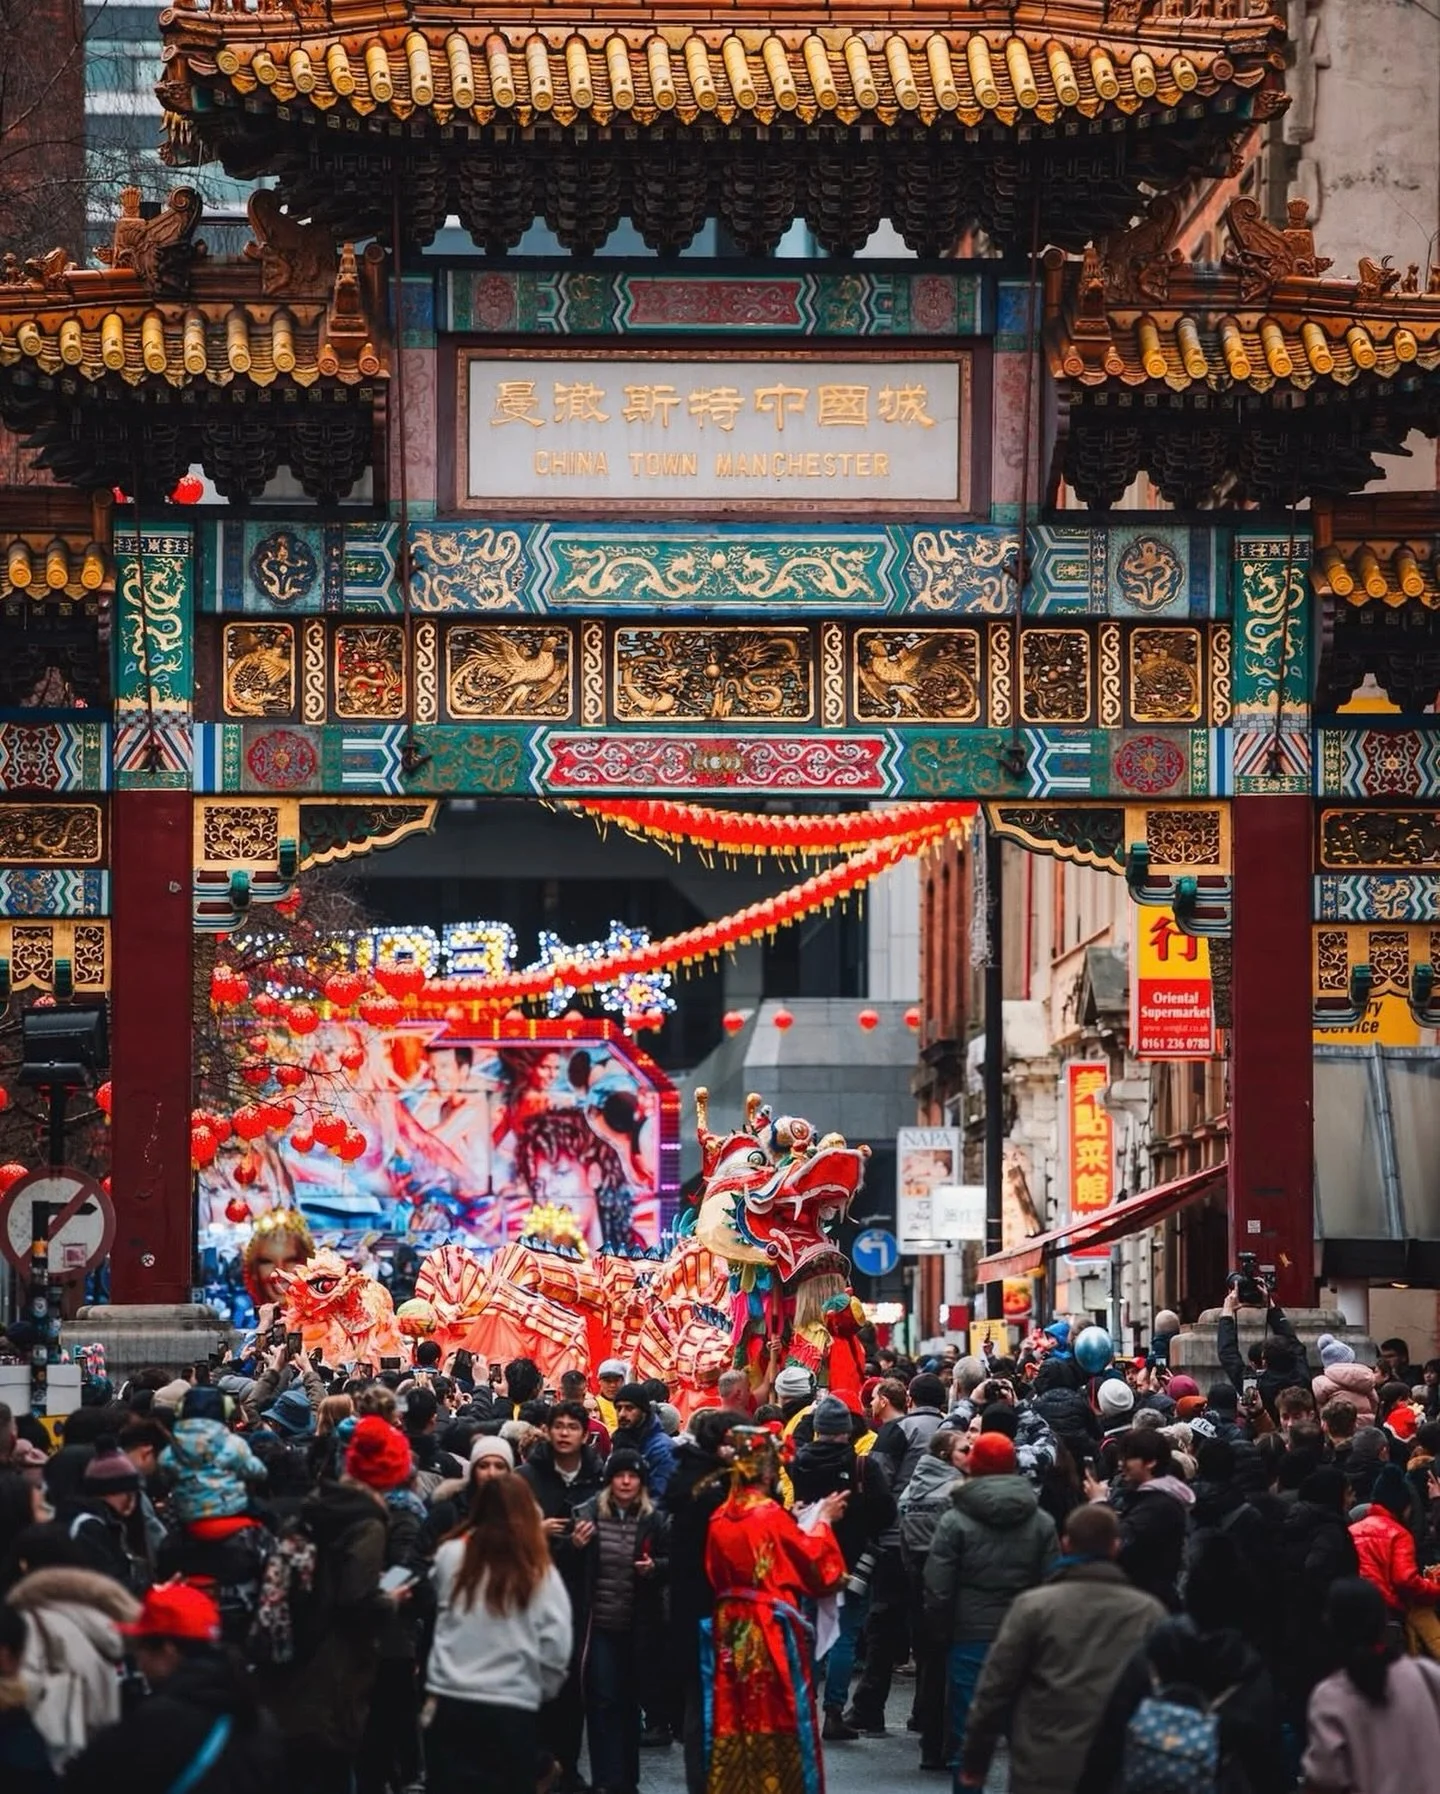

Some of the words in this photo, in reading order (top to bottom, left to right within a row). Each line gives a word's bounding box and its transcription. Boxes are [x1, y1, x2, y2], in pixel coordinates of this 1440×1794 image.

[534, 450, 609, 476] CHINA
[628, 452, 698, 477] TOWN
[715, 452, 891, 477] MANCHESTER
[1153, 992, 1199, 1004] Oriental
[1141, 1005, 1210, 1021] Supermarket
[1142, 1038, 1164, 1049] 0161
[1167, 1038, 1185, 1049] 236
[1186, 1038, 1210, 1049] 0788
[904, 1132, 952, 1147] NAPA
